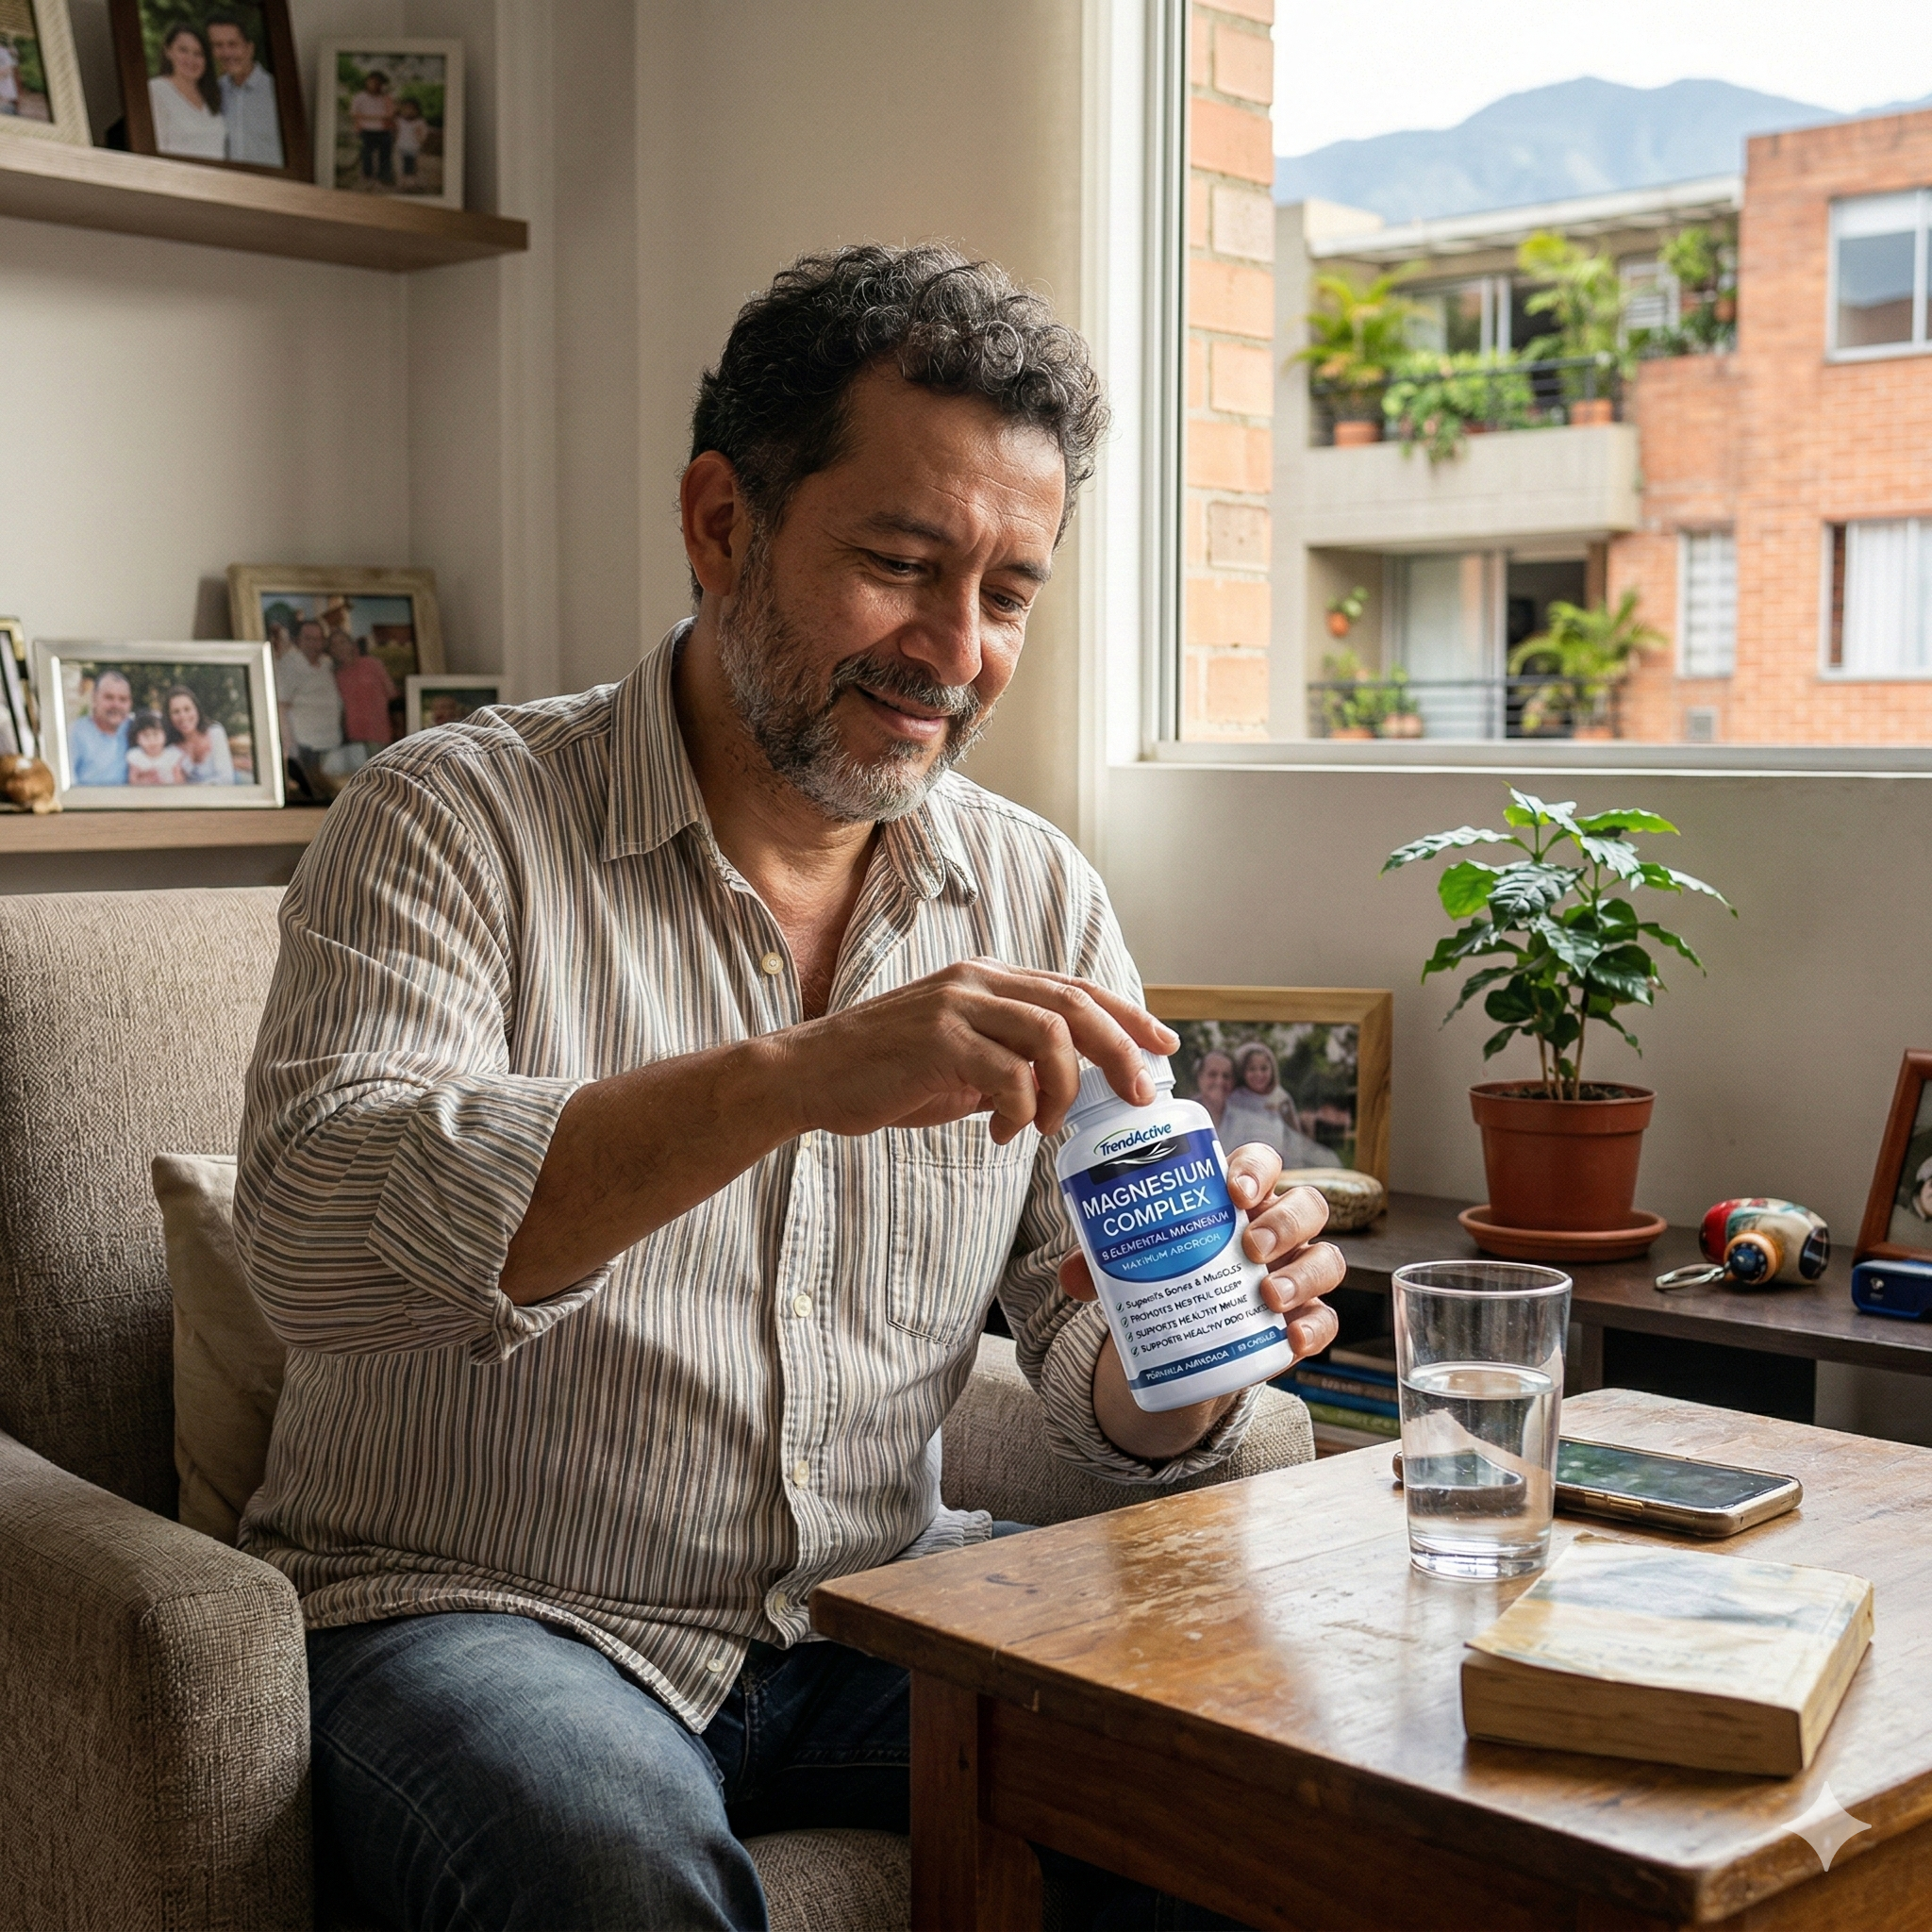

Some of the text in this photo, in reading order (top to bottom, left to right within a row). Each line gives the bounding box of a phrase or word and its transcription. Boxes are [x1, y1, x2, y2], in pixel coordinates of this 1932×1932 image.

[1100, 1124, 1172, 1156] TrendActive
[1082, 1158, 1215, 1219] MAGNESIUM
[1103, 1186, 1210, 1237] COMPLEX
